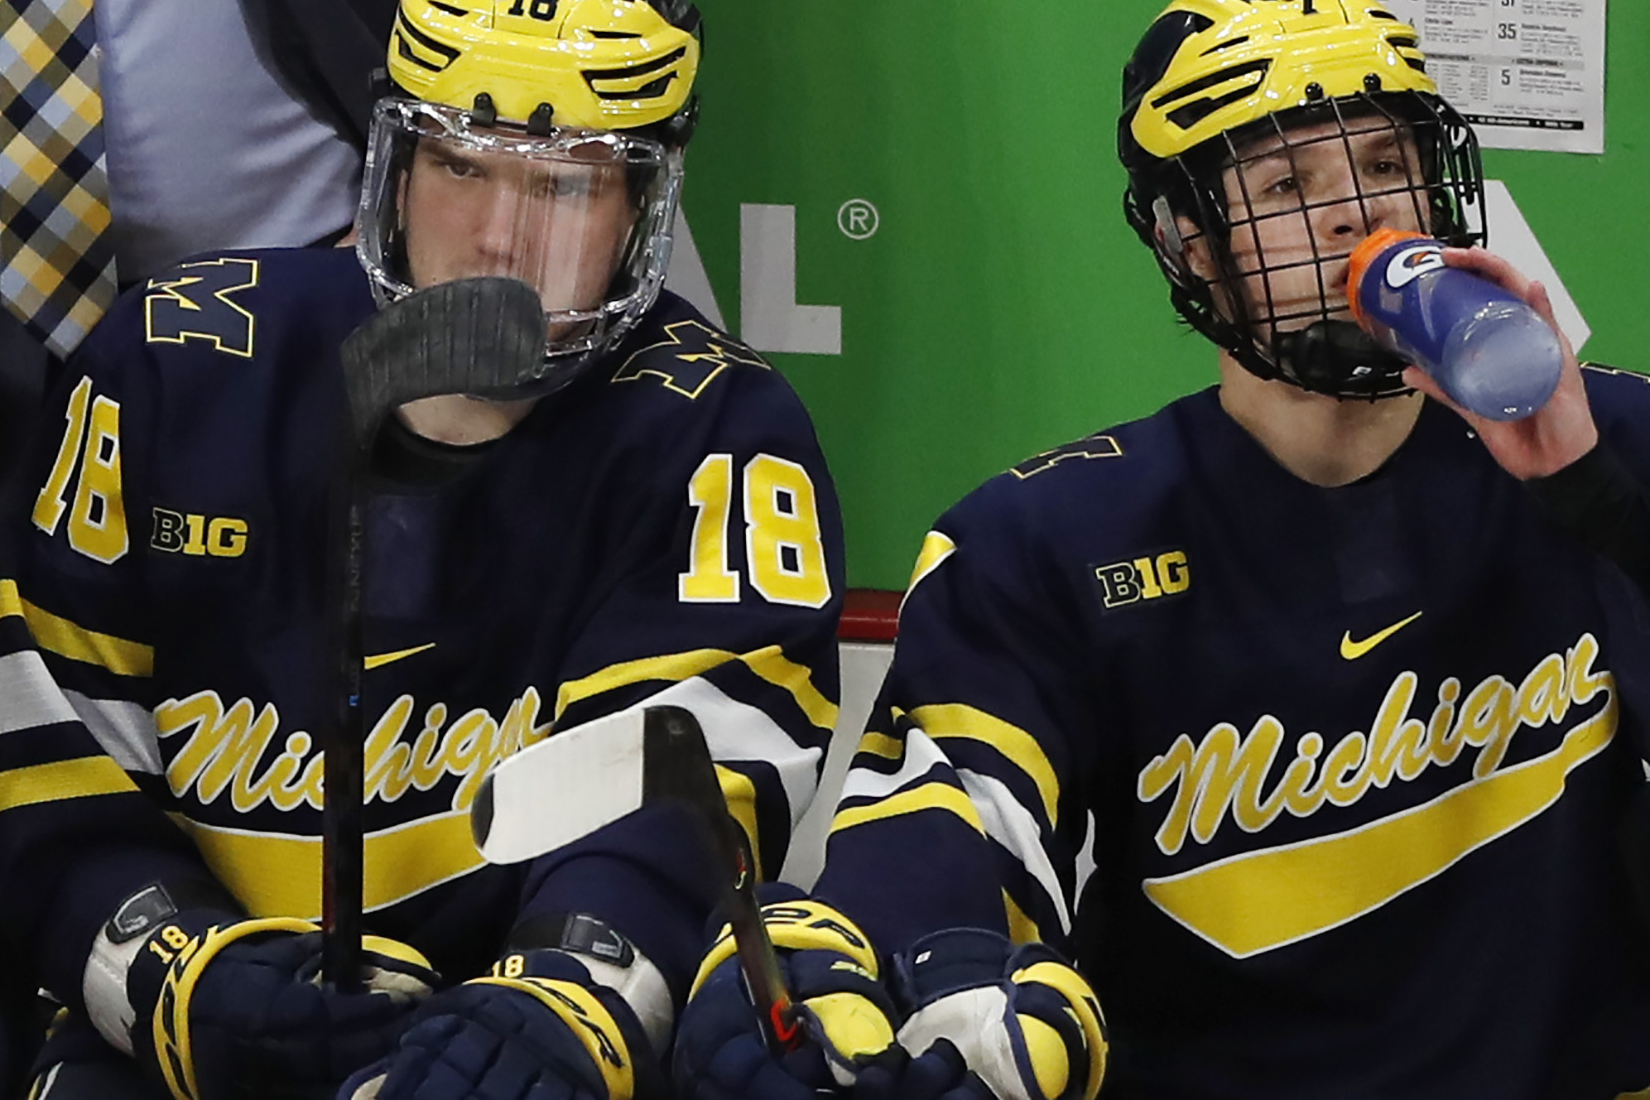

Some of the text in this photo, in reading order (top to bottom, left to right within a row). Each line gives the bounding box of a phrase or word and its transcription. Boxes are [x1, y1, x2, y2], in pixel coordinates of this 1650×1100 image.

[1498, 23, 1516, 39] 35
[1501, 69, 1510, 85] 5
[31, 375, 129, 565] 18
[678, 452, 832, 610] 18
[149, 925, 190, 965] 18
[491, 954, 525, 979] 18
